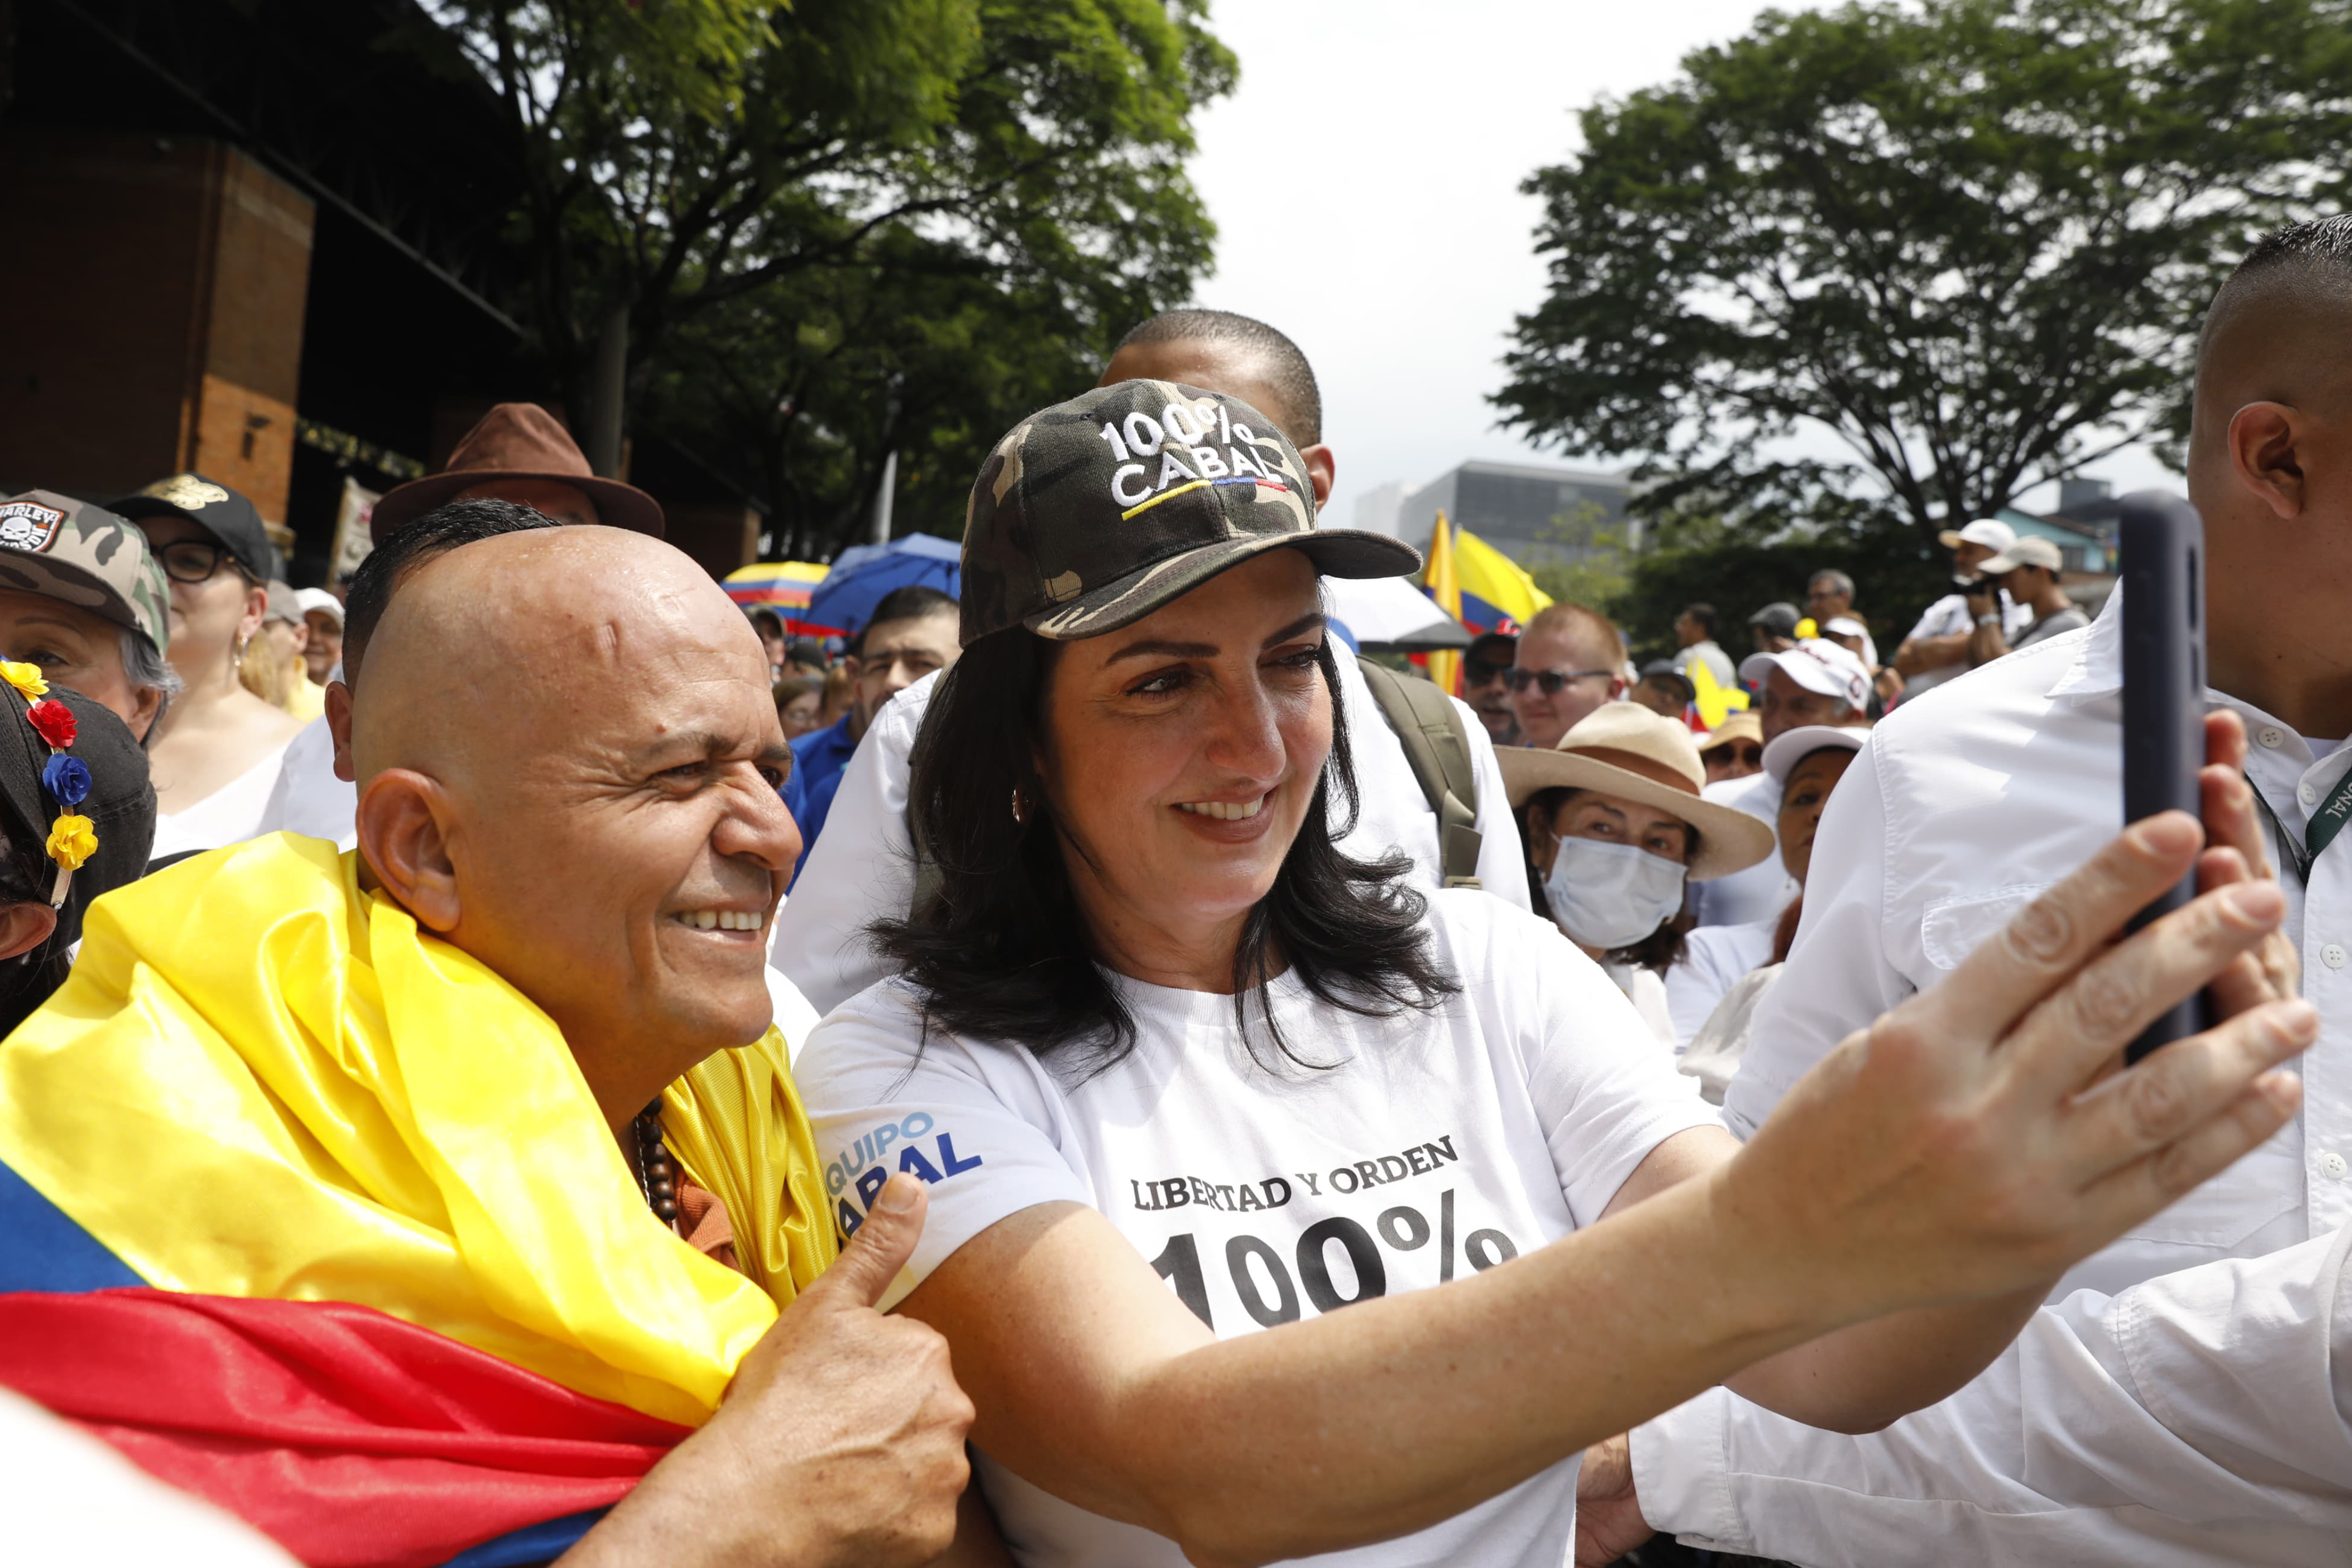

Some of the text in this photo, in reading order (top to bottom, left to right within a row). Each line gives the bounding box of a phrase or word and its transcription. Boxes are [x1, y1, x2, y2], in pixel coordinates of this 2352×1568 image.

[1099, 403, 1255, 462] 100%
[1111, 446, 1283, 507] CABAL
[826, 1112, 934, 1203] QUIPO
[838, 1132, 983, 1240] ABAL
[1130, 1135, 1458, 1212] LIBERTAD Y ORDEN
[1150, 1188, 1519, 1335] 100%
